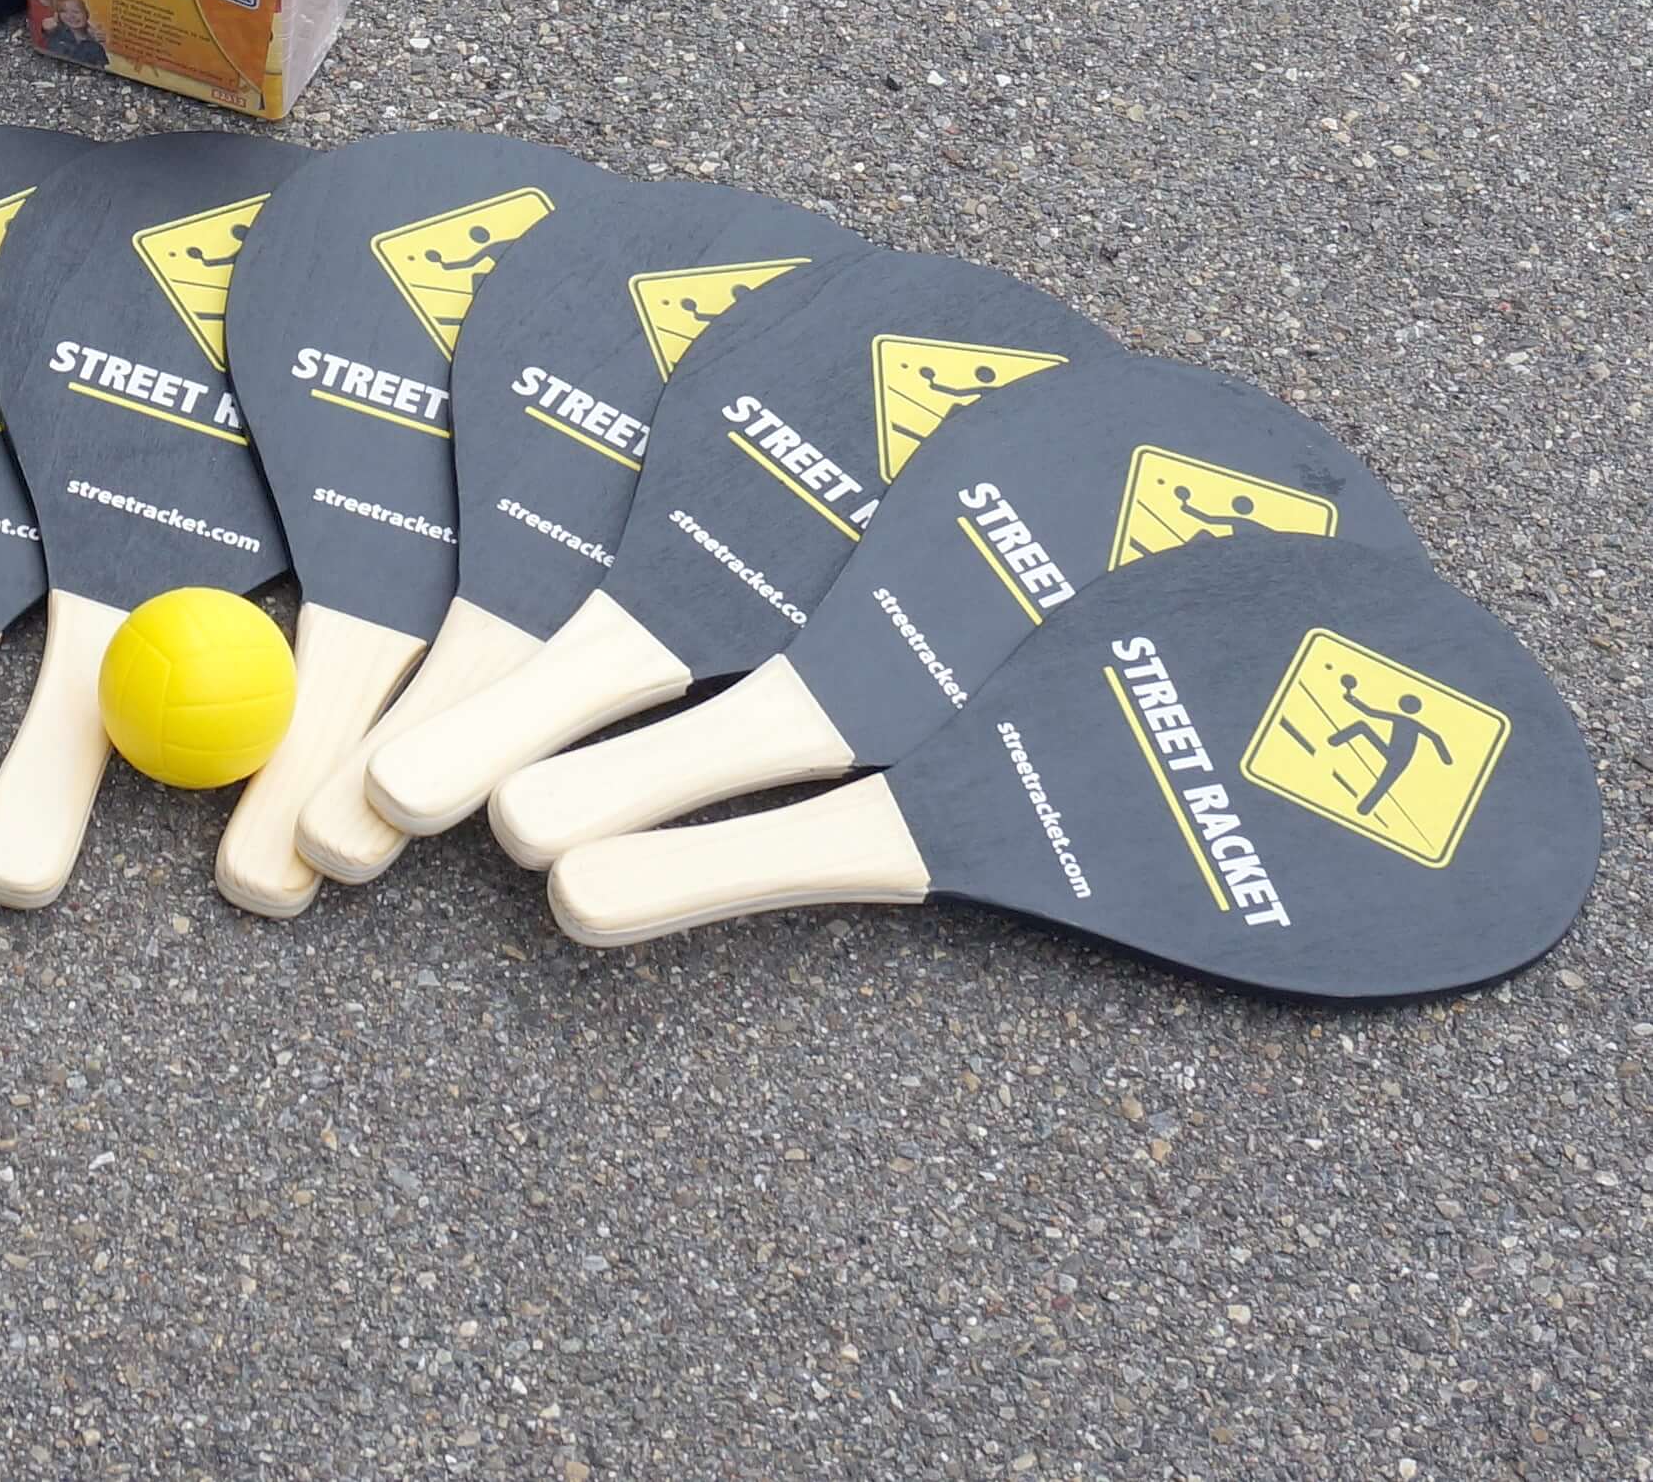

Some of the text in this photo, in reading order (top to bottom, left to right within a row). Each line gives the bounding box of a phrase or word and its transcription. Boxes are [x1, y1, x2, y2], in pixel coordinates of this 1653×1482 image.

[48, 340, 208, 414] STREET
[289, 347, 450, 421] STREET
[721, 395, 864, 502] STREET
[66, 479, 261, 554] streetracket.com
[668, 509, 808, 629] streetracket.co
[958, 482, 1077, 609] STREET
[996, 717, 1093, 900] streetracket.com
[1110, 636, 1293, 928] STREET RACKET
